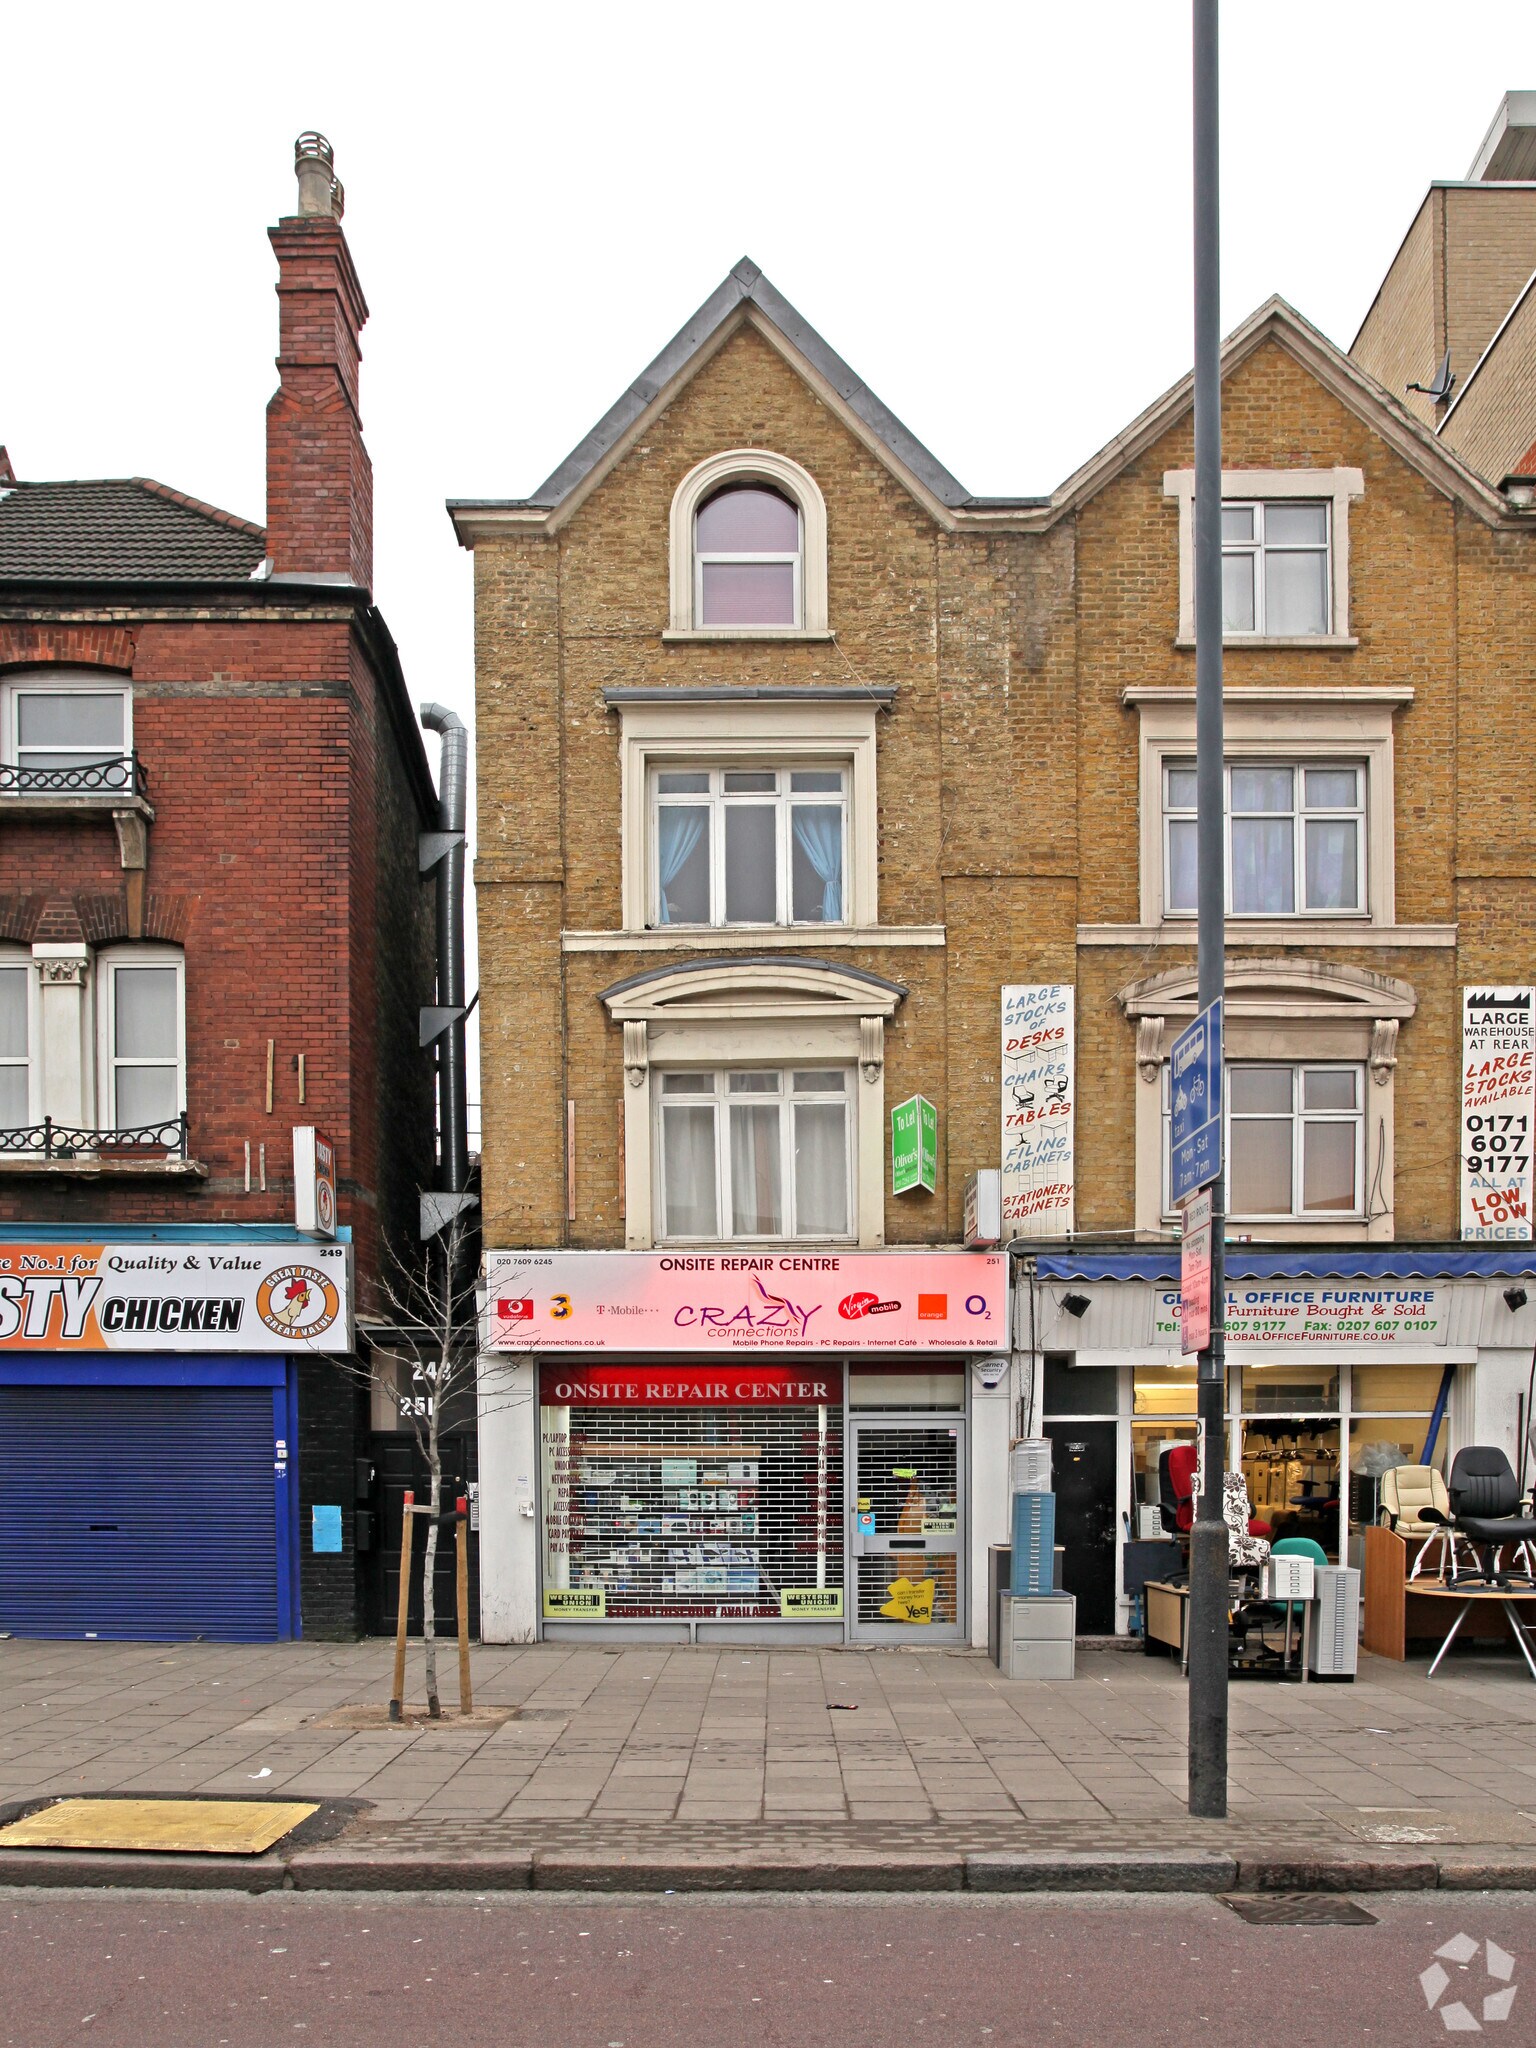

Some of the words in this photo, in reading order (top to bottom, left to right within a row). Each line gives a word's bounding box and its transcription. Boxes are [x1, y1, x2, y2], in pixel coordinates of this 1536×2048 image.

[1006, 986, 1061, 1010] LARGE
[1004, 1002, 1067, 1025] STOCKS
[1470, 1013, 1529, 1025] LARGE
[1029, 1018, 1046, 1030] OF
[1464, 1027, 1535, 1037] WAREHOUSE
[1005, 1027, 1065, 1051] DESKS
[1469, 1040, 1485, 1049] AT
[1493, 1040, 1529, 1049] REAR
[1004, 1063, 1066, 1086] CHAIRS
[1466, 1052, 1534, 1078] LARGE
[1464, 1070, 1532, 1094] STOCKS
[1465, 1086, 1533, 1107] AVAILABLE
[896, 1116, 904, 1131] To
[905, 1110, 915, 1127] Let
[1006, 1102, 1071, 1126] TABLES
[1466, 1115, 1527, 1132] 0171
[1174, 1118, 1185, 1138] taxi
[1006, 1137, 1067, 1160] FILING
[1471, 1135, 1526, 1152] 607
[895, 1147, 918, 1169] Oliver's
[1003, 1150, 1071, 1174] CABINETS
[1467, 1156, 1529, 1173] 9177
[1470, 1177, 1501, 1188] ALL
[1507, 1177, 1526, 1188] AT
[1003, 1183, 1074, 1206] STATIONERY
[1471, 1187, 1520, 1212] LOW
[1003, 1197, 1070, 1220] CABINETS
[1478, 1202, 1527, 1227] LOW
[1465, 1227, 1528, 1239] PRICES
[320, 1249, 343, 1257] 249
[20, 1255, 64, 1270] No.1
[67, 1255, 98, 1273] for
[108, 1255, 177, 1274] Quality
[183, 1256, 201, 1270] &
[209, 1256, 262, 1270] Value
[660, 1258, 715, 1271] ONSITE
[721, 1258, 774, 1271] REPAIR
[785, 1258, 840, 1271] CENTRE
[265, 1267, 297, 1287] GREAT
[299, 1267, 331, 1288] TASTE
[0, 1276, 103, 1337] STY
[102, 1297, 244, 1332] CHICKEN
[550, 1294, 574, 1320] 3
[842, 1294, 876, 1318] Virgin
[1162, 1293, 1238, 1305] GLL
[1245, 1292, 1315, 1304] OFFICE
[1322, 1291, 1435, 1303] FURNITURE
[871, 1303, 900, 1314] mobile
[919, 1311, 944, 1319] orange
[1227, 1305, 1300, 1317] Furniture
[1306, 1304, 1364, 1319] Bought
[1371, 1303, 1387, 1316] &
[1394, 1304, 1426, 1316] Sold
[264, 1314, 298, 1337] GREAT
[300, 1314, 333, 1337] VALUE
[673, 1304, 823, 1337] CRAZY
[1156, 1322, 1181, 1332] Tel:
[1252, 1321, 1287, 1331] 9177
[1304, 1321, 1332, 1331] Fax:
[1336, 1321, 1371, 1331] 0207
[1374, 1321, 1400, 1331] 607
[1404, 1321, 1438, 1331] 0107
[707, 1325, 800, 1338] connections
[497, 1339, 606, 1347] www.crazyconnections.co.uk
[898, 1339, 917, 1347] Café
[555, 1382, 639, 1399] ONSITE
[646, 1383, 729, 1399] REPAIR
[735, 1382, 829, 1398] CENTER
[400, 1396, 434, 1416] 251
[542, 1432, 567, 1443] PC/LAPTOP
[906, 1604, 930, 1618] Yes!
